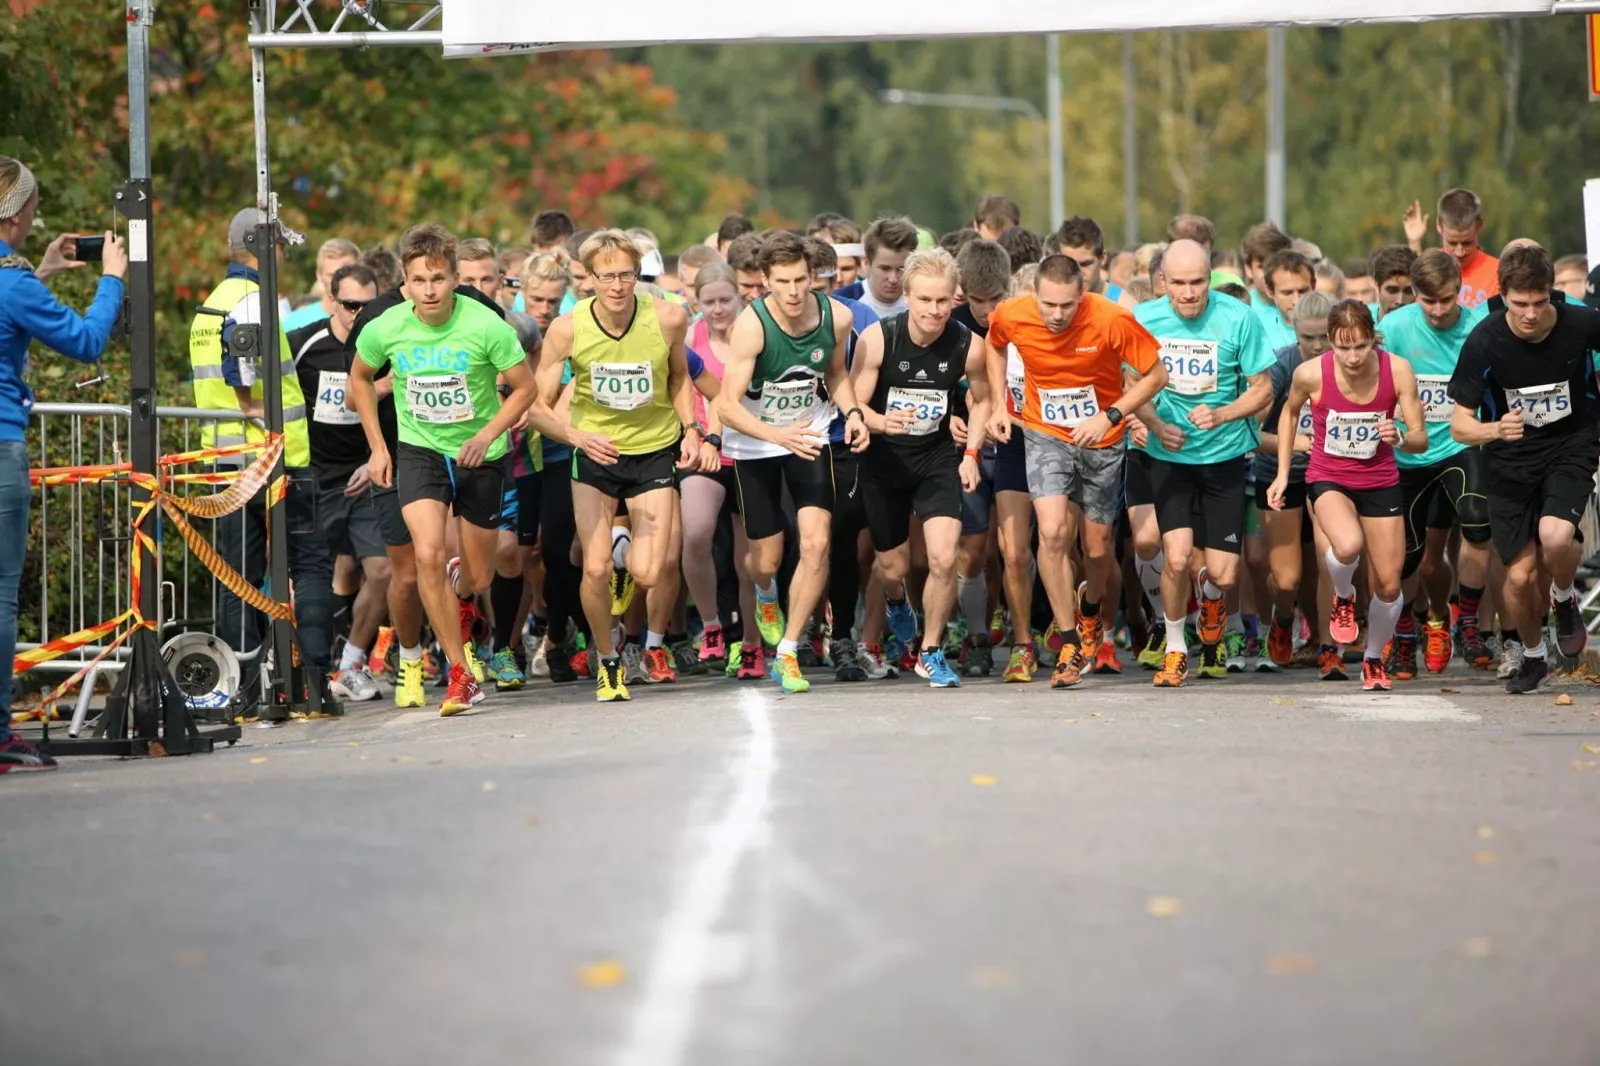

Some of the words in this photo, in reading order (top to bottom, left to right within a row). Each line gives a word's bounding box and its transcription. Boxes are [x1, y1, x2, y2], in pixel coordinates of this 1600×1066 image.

[397, 346, 471, 373] ASICS
[1162, 356, 1215, 376] 6164
[594, 376, 650, 393] 7010
[320, 388, 346, 406] 49
[410, 387, 467, 408] 7065
[764, 392, 814, 410] 7036
[1420, 389, 1455, 405] 03
[1511, 395, 1568, 413] 4715
[1044, 400, 1096, 421] 6115
[1328, 426, 1380, 442] 4192
